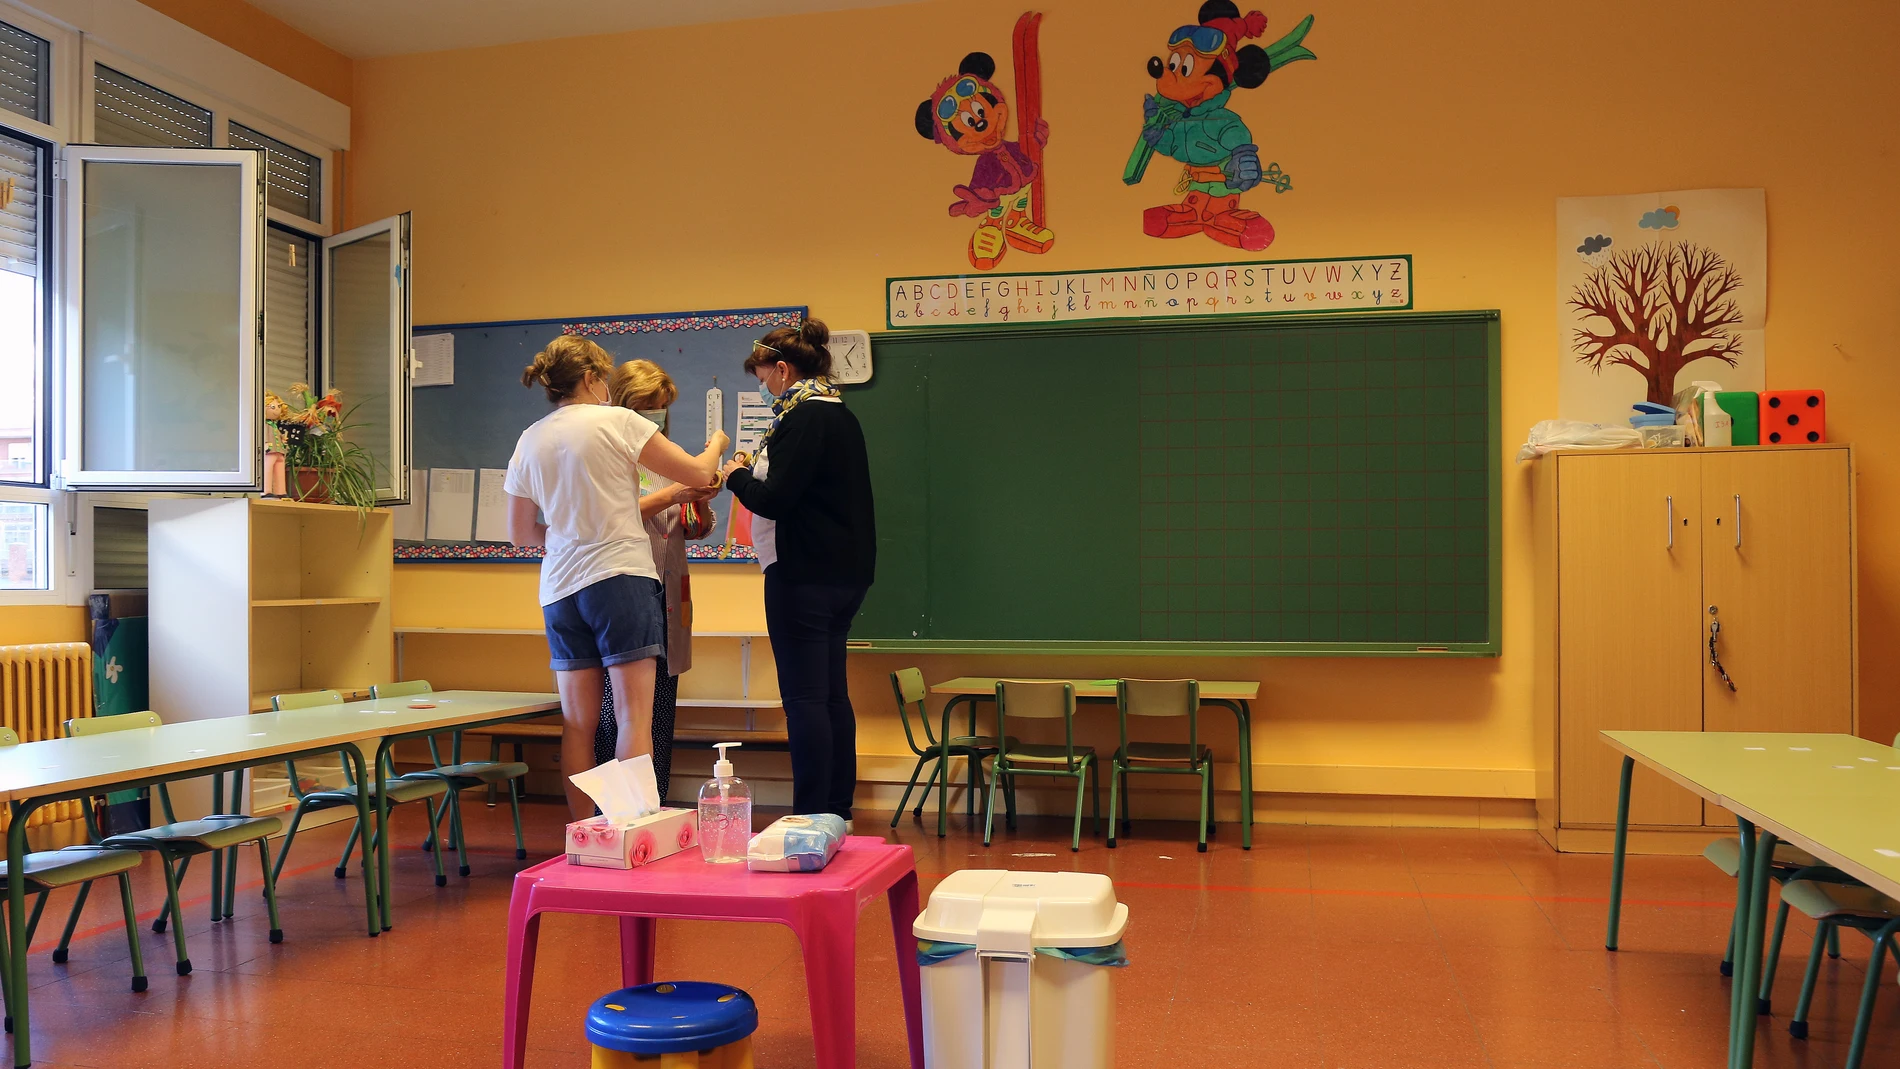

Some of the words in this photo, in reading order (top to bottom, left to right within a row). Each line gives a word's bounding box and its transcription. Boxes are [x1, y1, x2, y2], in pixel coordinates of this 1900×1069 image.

[896, 285, 908, 301] A
[914, 285, 924, 300] B
[930, 284, 941, 300] C
[947, 283, 958, 299] D
[966, 283, 974, 298] E
[982, 282, 991, 298] F
[998, 281, 1010, 297] G
[1017, 281, 1028, 297] H
[1035, 280, 1044, 296] I
[1050, 280, 1060, 296] J
[1067, 279, 1076, 295] K
[1083, 278, 1092, 294] L
[1101, 277, 1115, 293] M
[1124, 276, 1137, 292] N
[1144, 273, 1155, 291] Ñ
[1165, 273, 1179, 290] O
[1187, 273, 1198, 289] P
[1206, 271, 1219, 290] Q
[1226, 270, 1237, 287] R
[1244, 269, 1255, 286] S
[1262, 268, 1275, 286] T
[1283, 267, 1295, 285] U
[1303, 266, 1317, 284] V
[1326, 265, 1342, 283] W
[1351, 264, 1364, 282] X
[1371, 264, 1383, 281] Y
[1390, 263, 1402, 281] Z
[896, 308, 908, 318] a
[914, 303, 924, 317] b
[931, 308, 941, 317] c
[947, 304, 960, 316] d
[966, 307, 976, 316] e
[984, 300, 991, 317] f
[999, 306, 1010, 321] g
[1017, 299, 1029, 314] h
[1036, 301, 1043, 313] i
[1051, 301, 1058, 319] j
[1067, 296, 1076, 311] k
[1084, 296, 1091, 310] l
[1100, 300, 1117, 310] m
[1124, 299, 1137, 309] n
[1145, 297, 1158, 308] ñ
[1166, 298, 1179, 307] o
[1187, 297, 1198, 313] p
[1206, 296, 1219, 312] q
[1227, 295, 1237, 305] r
[1245, 295, 1255, 304] s
[1265, 288, 1272, 303] t
[1283, 293, 1296, 303] u
[1304, 291, 1317, 301] v
[1325, 290, 1343, 300] w
[1351, 290, 1365, 300] x
[1373, 290, 1383, 306] y
[1391, 288, 1402, 298] z
